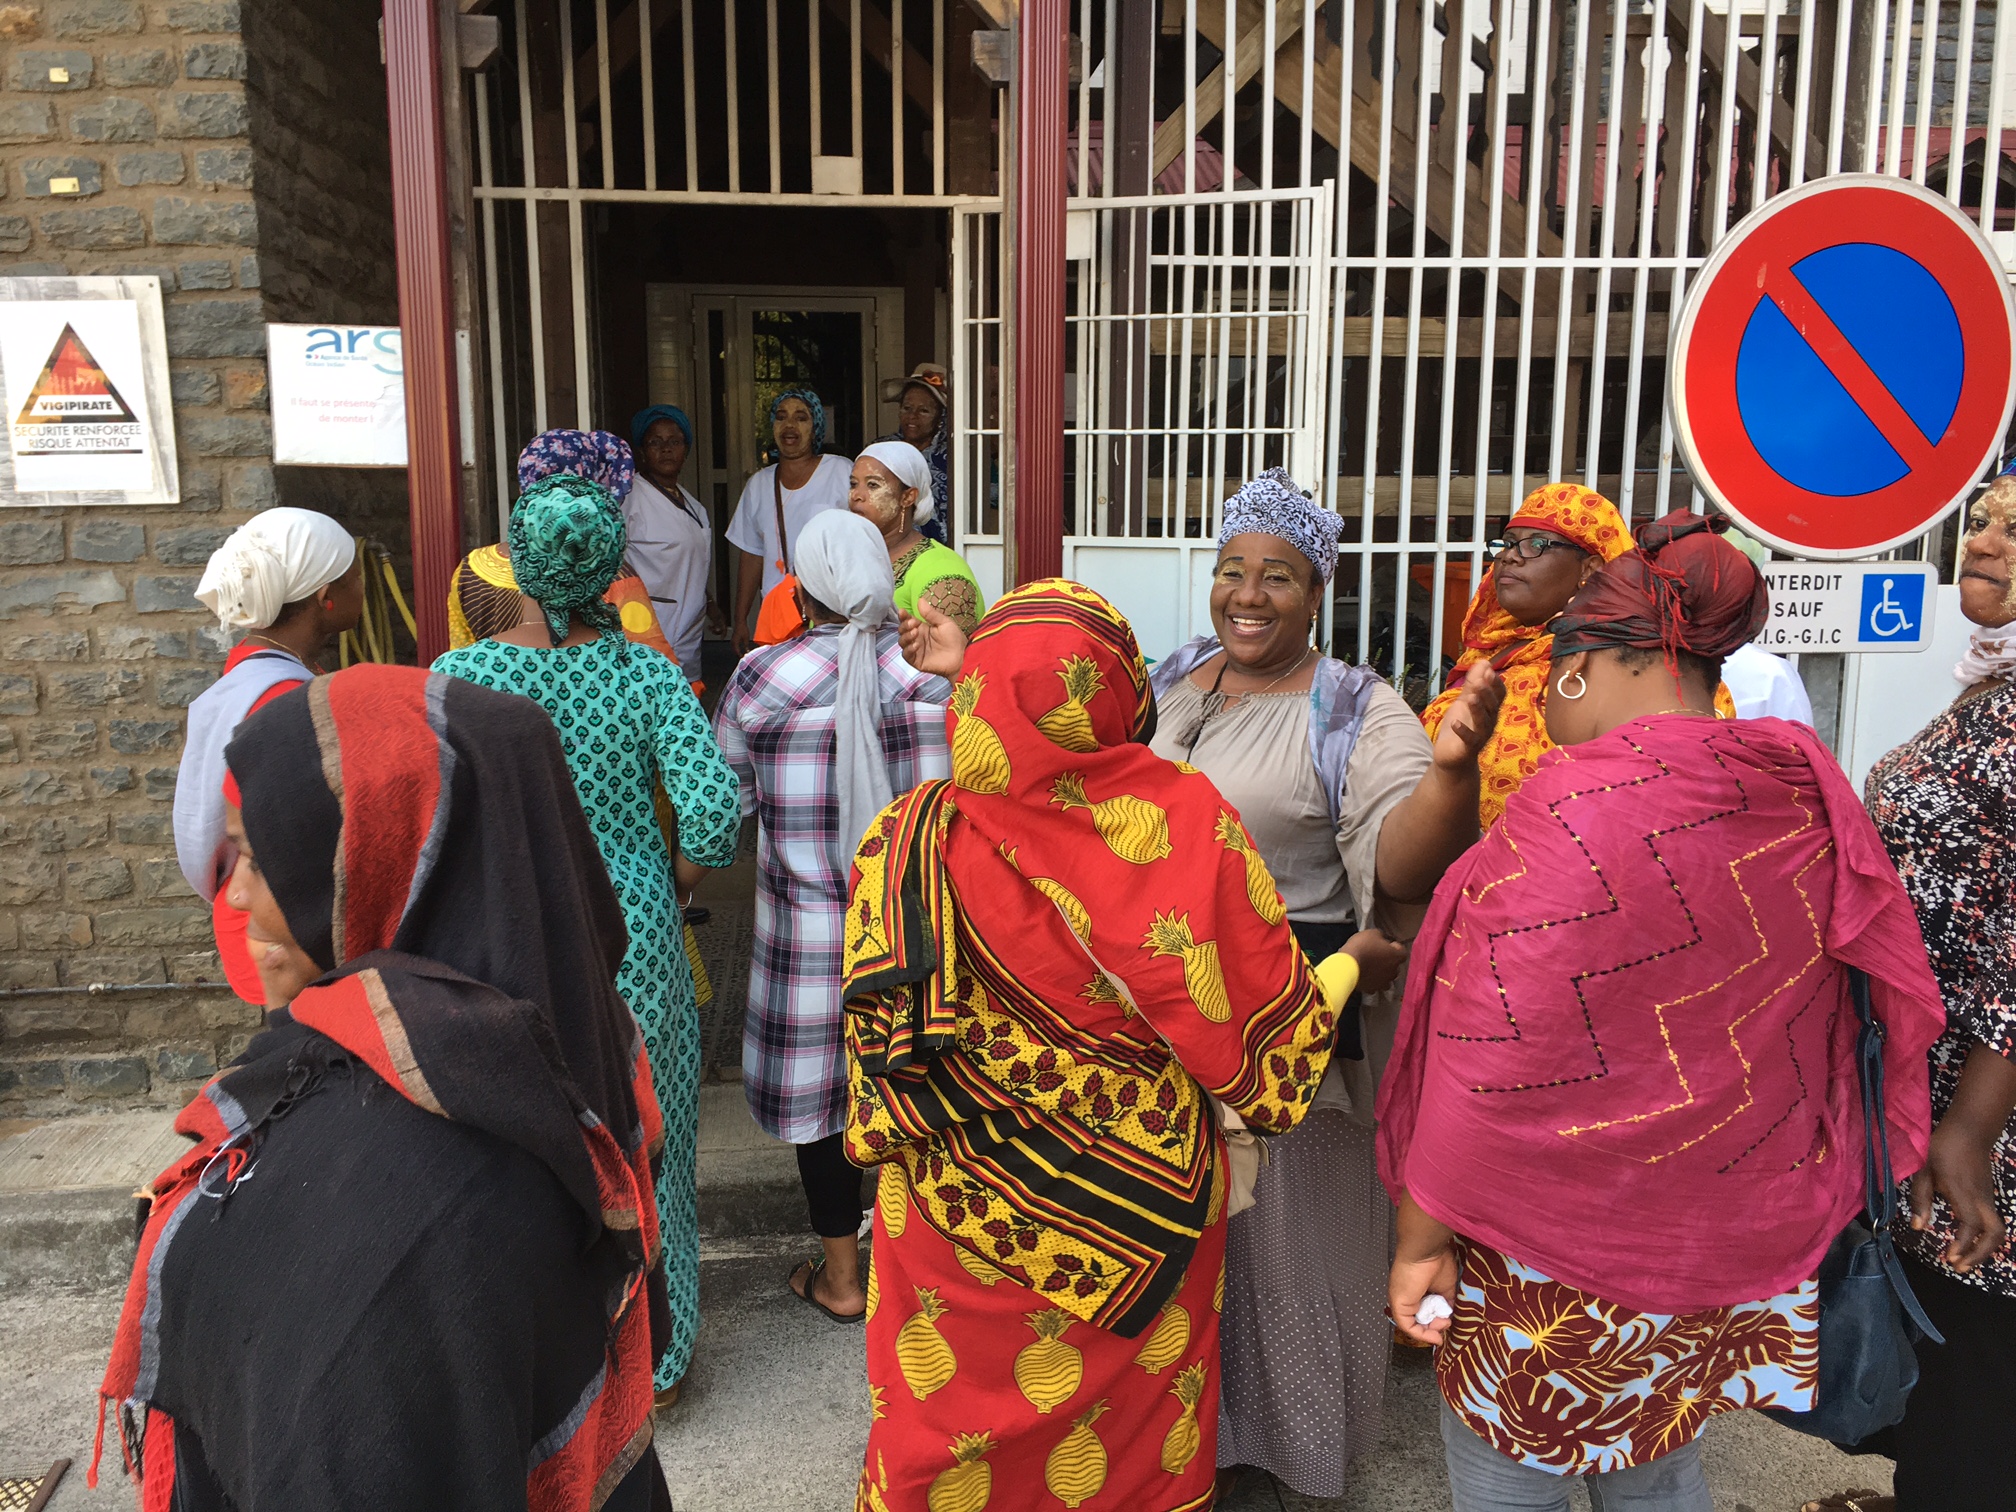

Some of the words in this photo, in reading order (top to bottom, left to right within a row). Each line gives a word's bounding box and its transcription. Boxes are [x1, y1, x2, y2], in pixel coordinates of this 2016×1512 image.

[306, 328, 403, 376] ars
[40, 401, 113, 411] VIGIPIRATE
[299, 397, 318, 407] faut
[319, 414, 330, 422] de
[333, 415, 368, 423] monter
[15, 425, 70, 437] SECURITE
[73, 425, 142, 435] RENFORCEE
[28, 438, 72, 449] RISQUE
[76, 437, 131, 448] ATTENTAT
[1765, 575, 1842, 590] NTERDIT
[1774, 602, 1823, 617] SAUF
[1750, 628, 1841, 644] .I.G.-G.I.C
